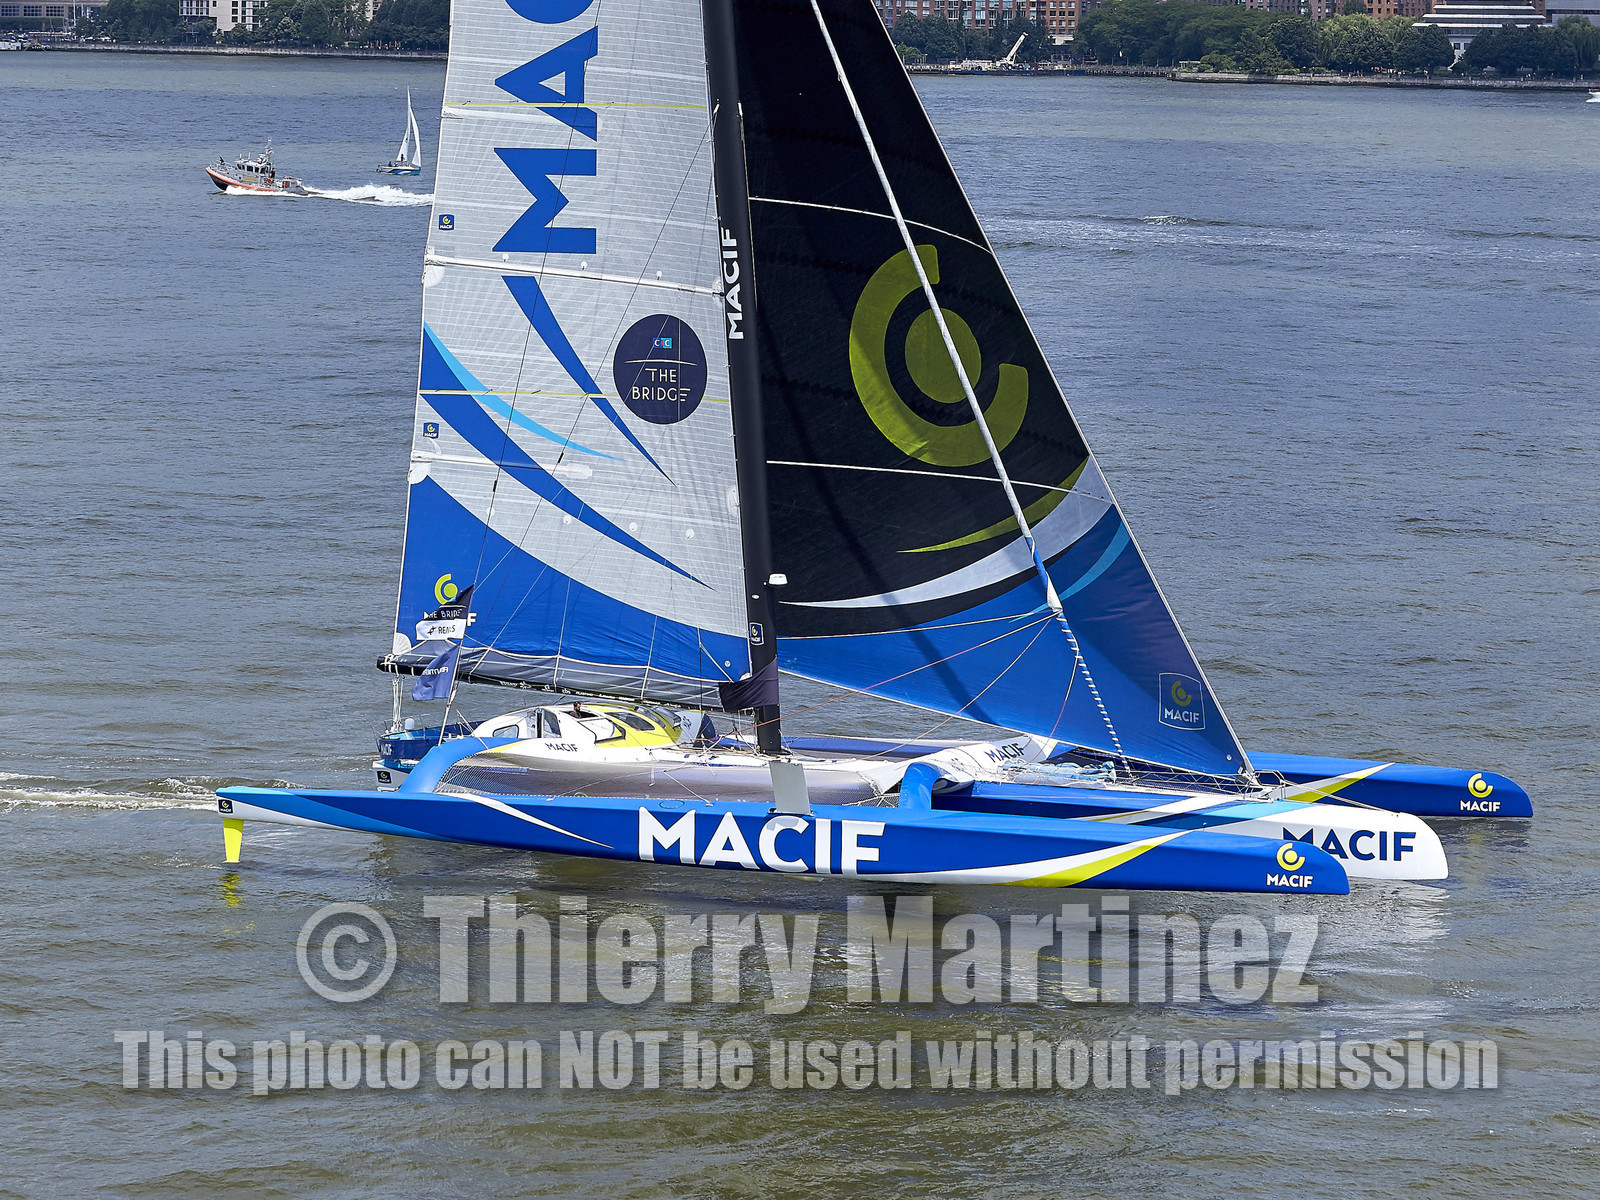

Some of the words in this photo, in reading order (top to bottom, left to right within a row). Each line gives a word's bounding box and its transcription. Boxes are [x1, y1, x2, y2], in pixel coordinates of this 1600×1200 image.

[720, 226, 744, 340] MACIF
[645, 368, 677, 383] THE
[632, 386, 691, 402] BRIDGE
[1164, 707, 1200, 723] MACIF
[544, 742, 578, 752] MACIF
[984, 742, 1024, 763] MACIF
[1460, 800, 1501, 813] MACIF
[638, 806, 886, 875] MACIF
[1266, 873, 1314, 888] MACIF
